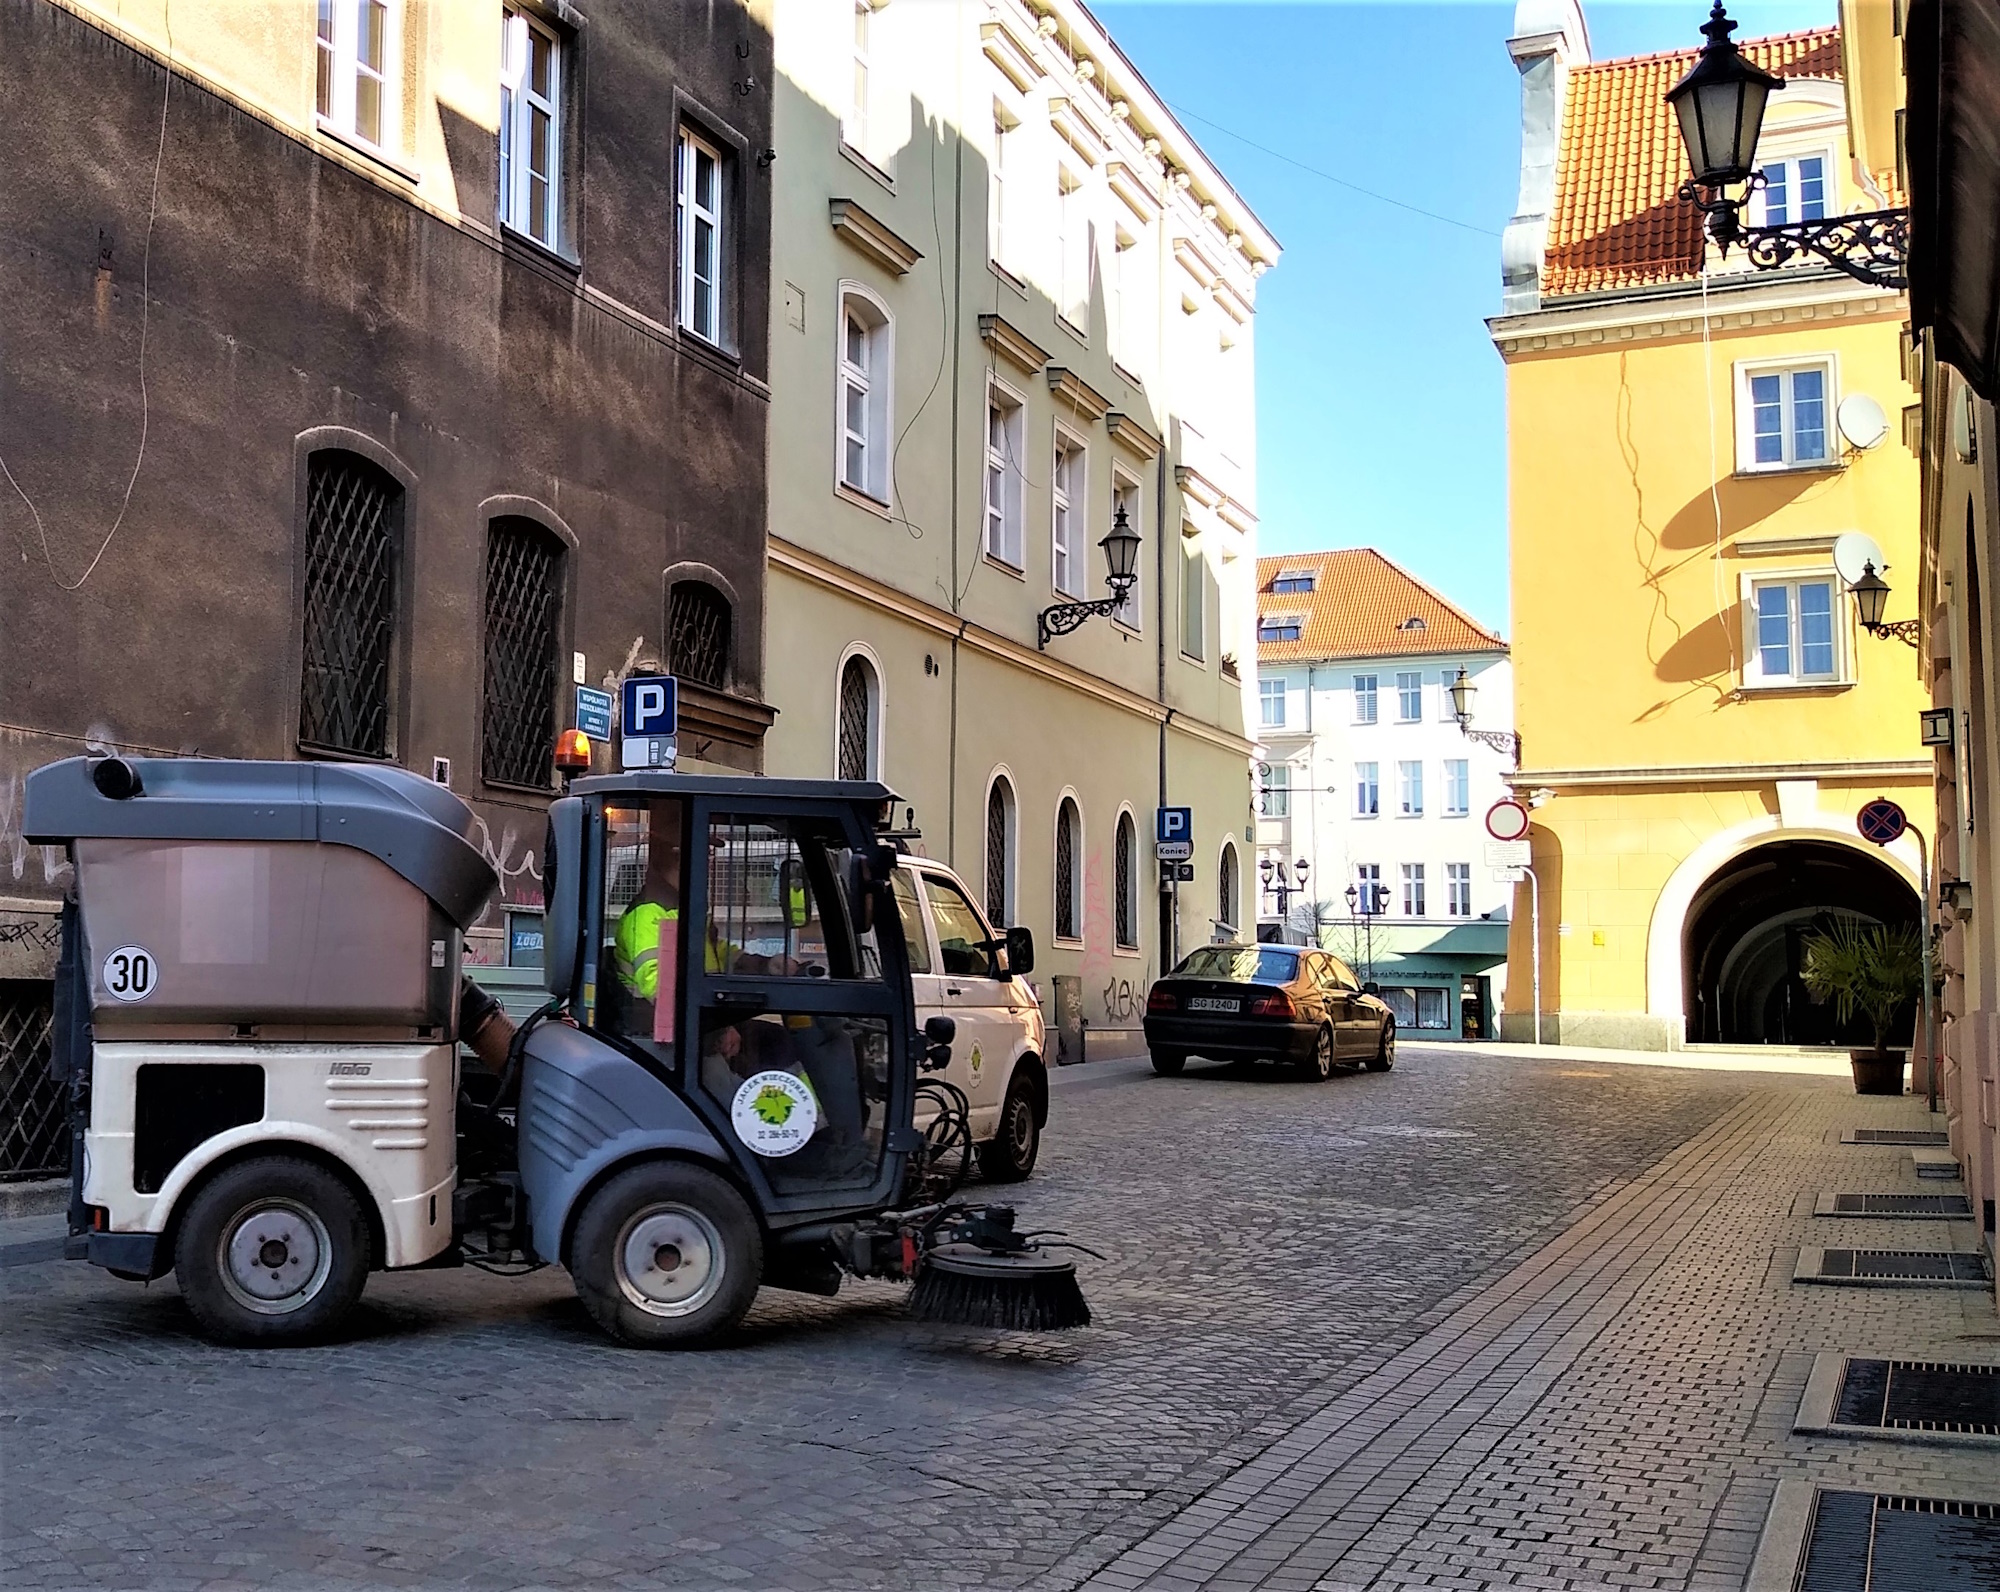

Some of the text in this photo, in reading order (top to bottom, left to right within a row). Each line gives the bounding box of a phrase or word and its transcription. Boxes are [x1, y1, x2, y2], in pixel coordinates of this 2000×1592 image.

[635, 684, 665, 731] P
[1164, 812, 1184, 837] P
[1159, 847, 1188, 855] Koniec
[112, 954, 148, 993] 30
[1193, 999, 1238, 1009] SG 1240J
[329, 1062, 373, 1076] Hako
[737, 1074, 809, 1105] JACEK WIECZOREK
